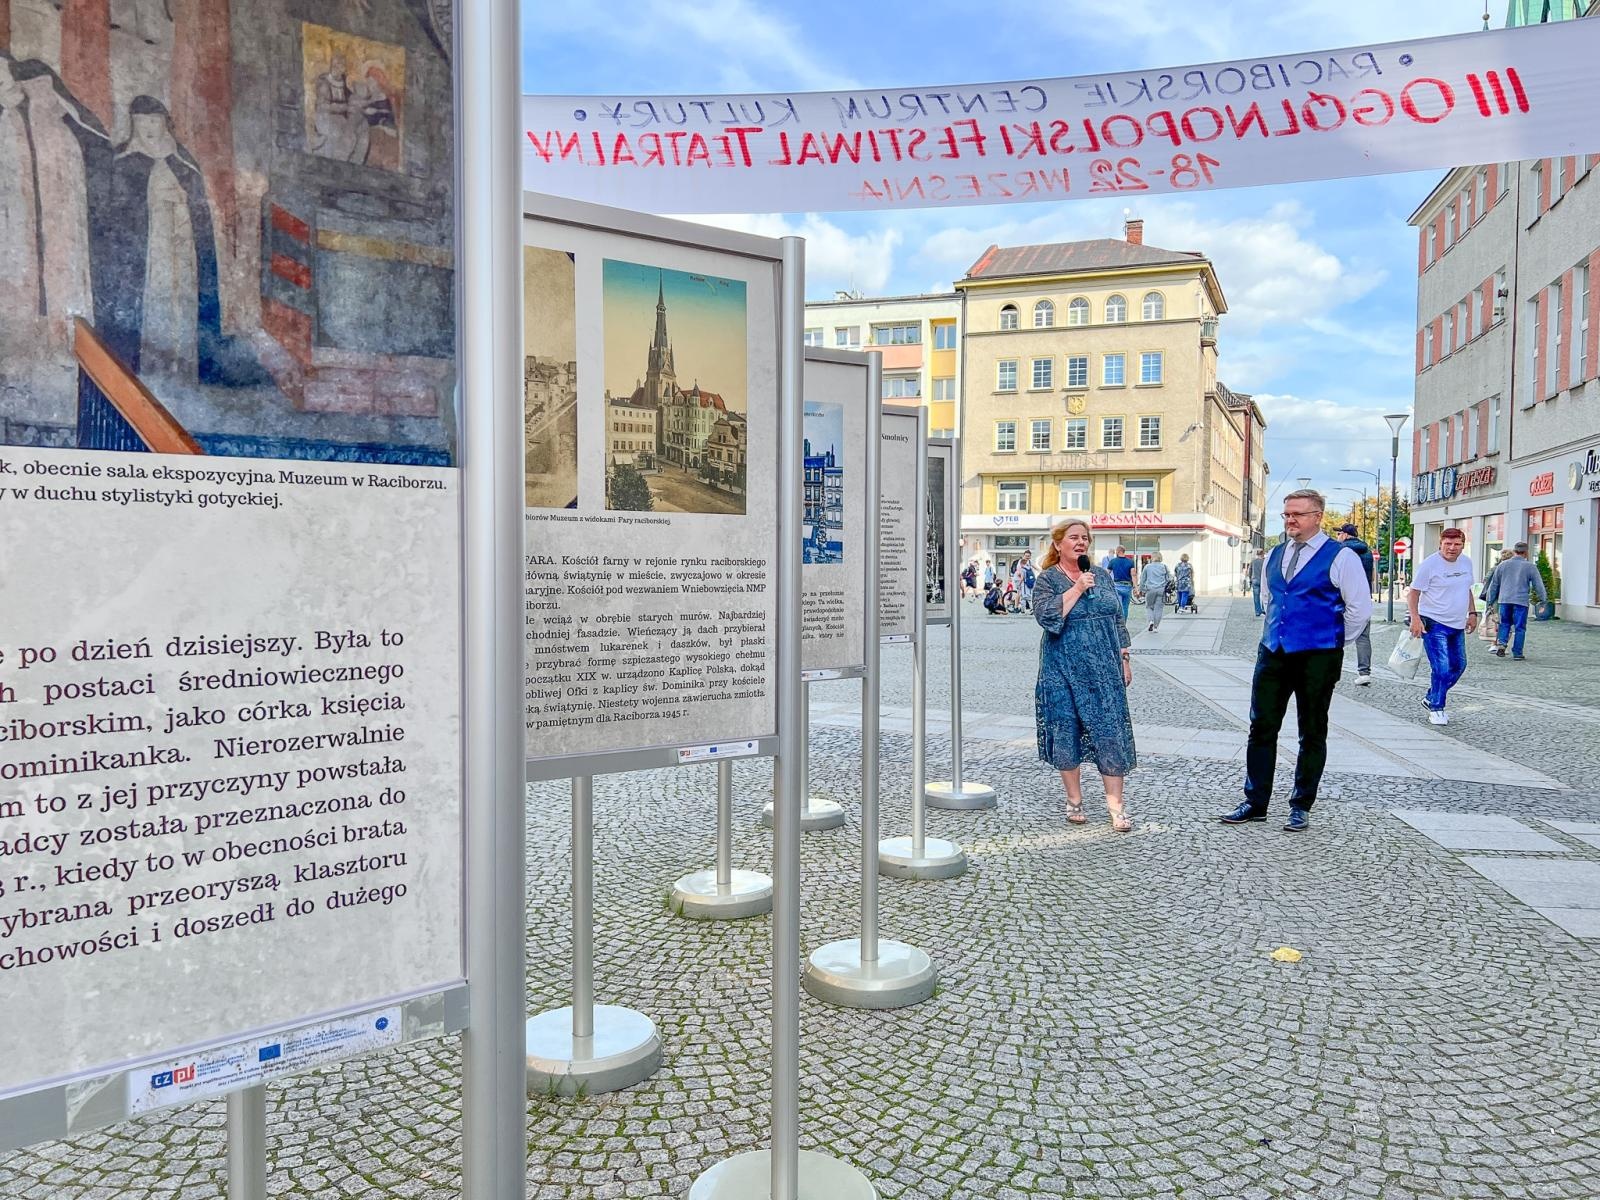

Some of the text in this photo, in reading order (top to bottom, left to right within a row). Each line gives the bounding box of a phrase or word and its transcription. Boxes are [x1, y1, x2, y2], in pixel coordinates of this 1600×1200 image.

[23, 459, 102, 477] obecnie
[106, 464, 149, 479] sala
[152, 465, 276, 486] ekspozycyjna
[278, 470, 348, 486] Muzeum
[351, 476, 365, 487] w
[367, 474, 447, 490] Raciborzu.
[10, 488, 30, 500] w
[34, 485, 98, 501] duchu
[101, 488, 194, 507] stylistyki
[197, 491, 283, 510] gotyckiej.
[1091, 515, 1163, 524] ROSSMANN
[562, 555, 599, 565] Kościół
[602, 556, 630, 568] farny
[645, 556, 677, 568] rejonie
[680, 557, 707, 568] rynku
[710, 557, 766, 568] raciborskiego
[525, 570, 560, 582] łówną
[563, 570, 612, 582] świątynię
[628, 570, 666, 580] mieście,
[670, 571, 722, 582] zwyczajowo
[736, 571, 766, 579] okresie
[525, 584, 766, 598] aryjne. Kościół pod wezwaniem Wniebowzięcia NMP
[543, 615, 572, 626] wciąż
[578, 616, 589, 625] w
[596, 613, 631, 624] obrębie
[638, 612, 673, 624] starych
[680, 611, 712, 621] murów.
[718, 610, 766, 621] Najbardziej
[577, 628, 620, 638] fasadzie.
[627, 626, 678, 638] Wieńczący
[682, 625, 692, 637] ją
[697, 625, 718, 634] dach
[724, 623, 766, 635] przybierał
[18, 646, 57, 670] po
[71, 637, 154, 662] dzień
[166, 633, 303, 659] dzisiejszy.
[314, 629, 371, 654] Była
[380, 628, 404, 647] to
[600, 640, 649, 652] lukarenek
[658, 640, 661, 649] i
[670, 638, 710, 649] daszków,
[719, 637, 732, 648] był
[740, 636, 766, 648] płaski
[536, 658, 582, 671] przybrać
[588, 657, 616, 667] formę
[622, 655, 680, 667] szpiczastego
[686, 651, 730, 663] wysokiego
[735, 650, 766, 659] chełmu
[576, 671, 596, 681] XIX
[616, 669, 665, 680] urządzono
[669, 666, 702, 677] Kaplicę
[706, 664, 736, 674] Polską,
[740, 662, 765, 673] dokąd
[42, 672, 156, 706] postaci
[178, 664, 404, 692] średniowiecznego
[566, 686, 588, 697] Ofki
[603, 684, 638, 696] kaplicy
[642, 683, 658, 692] św.
[662, 678, 707, 690] Dominika
[709, 680, 728, 689] przy
[732, 676, 766, 686] kościele
[163, 706, 226, 734] jako
[238, 699, 312, 722] córka
[320, 691, 406, 717] księcia
[526, 689, 766, 715] ką świątynię. Niestety wojenna zawierucha zmiotła
[536, 716, 594, 730] pamiętnym
[596, 714, 612, 723] dla
[613, 711, 660, 722] Raciborza
[662, 710, 681, 719] 1945
[0, 723, 405, 780] ominikanka. Nierozerwalnie
[34, 793, 66, 814] to
[77, 793, 93, 810] z
[99, 782, 137, 813] jej
[146, 771, 291, 807] przyczyny
[296, 755, 407, 789] powstała
[80, 815, 188, 846] została
[194, 794, 372, 836] przeznaczona
[379, 787, 406, 806] do
[13, 875, 46, 893] r.,
[54, 857, 140, 887] kiedy
[144, 852, 174, 873] to
[181, 851, 205, 867] w
[212, 826, 338, 864] obecności
[344, 819, 408, 843] brata
[0, 852, 408, 938] ybrana przeoryszą klasztoru
[0, 883, 407, 970] chowości i doszedł do dużego
